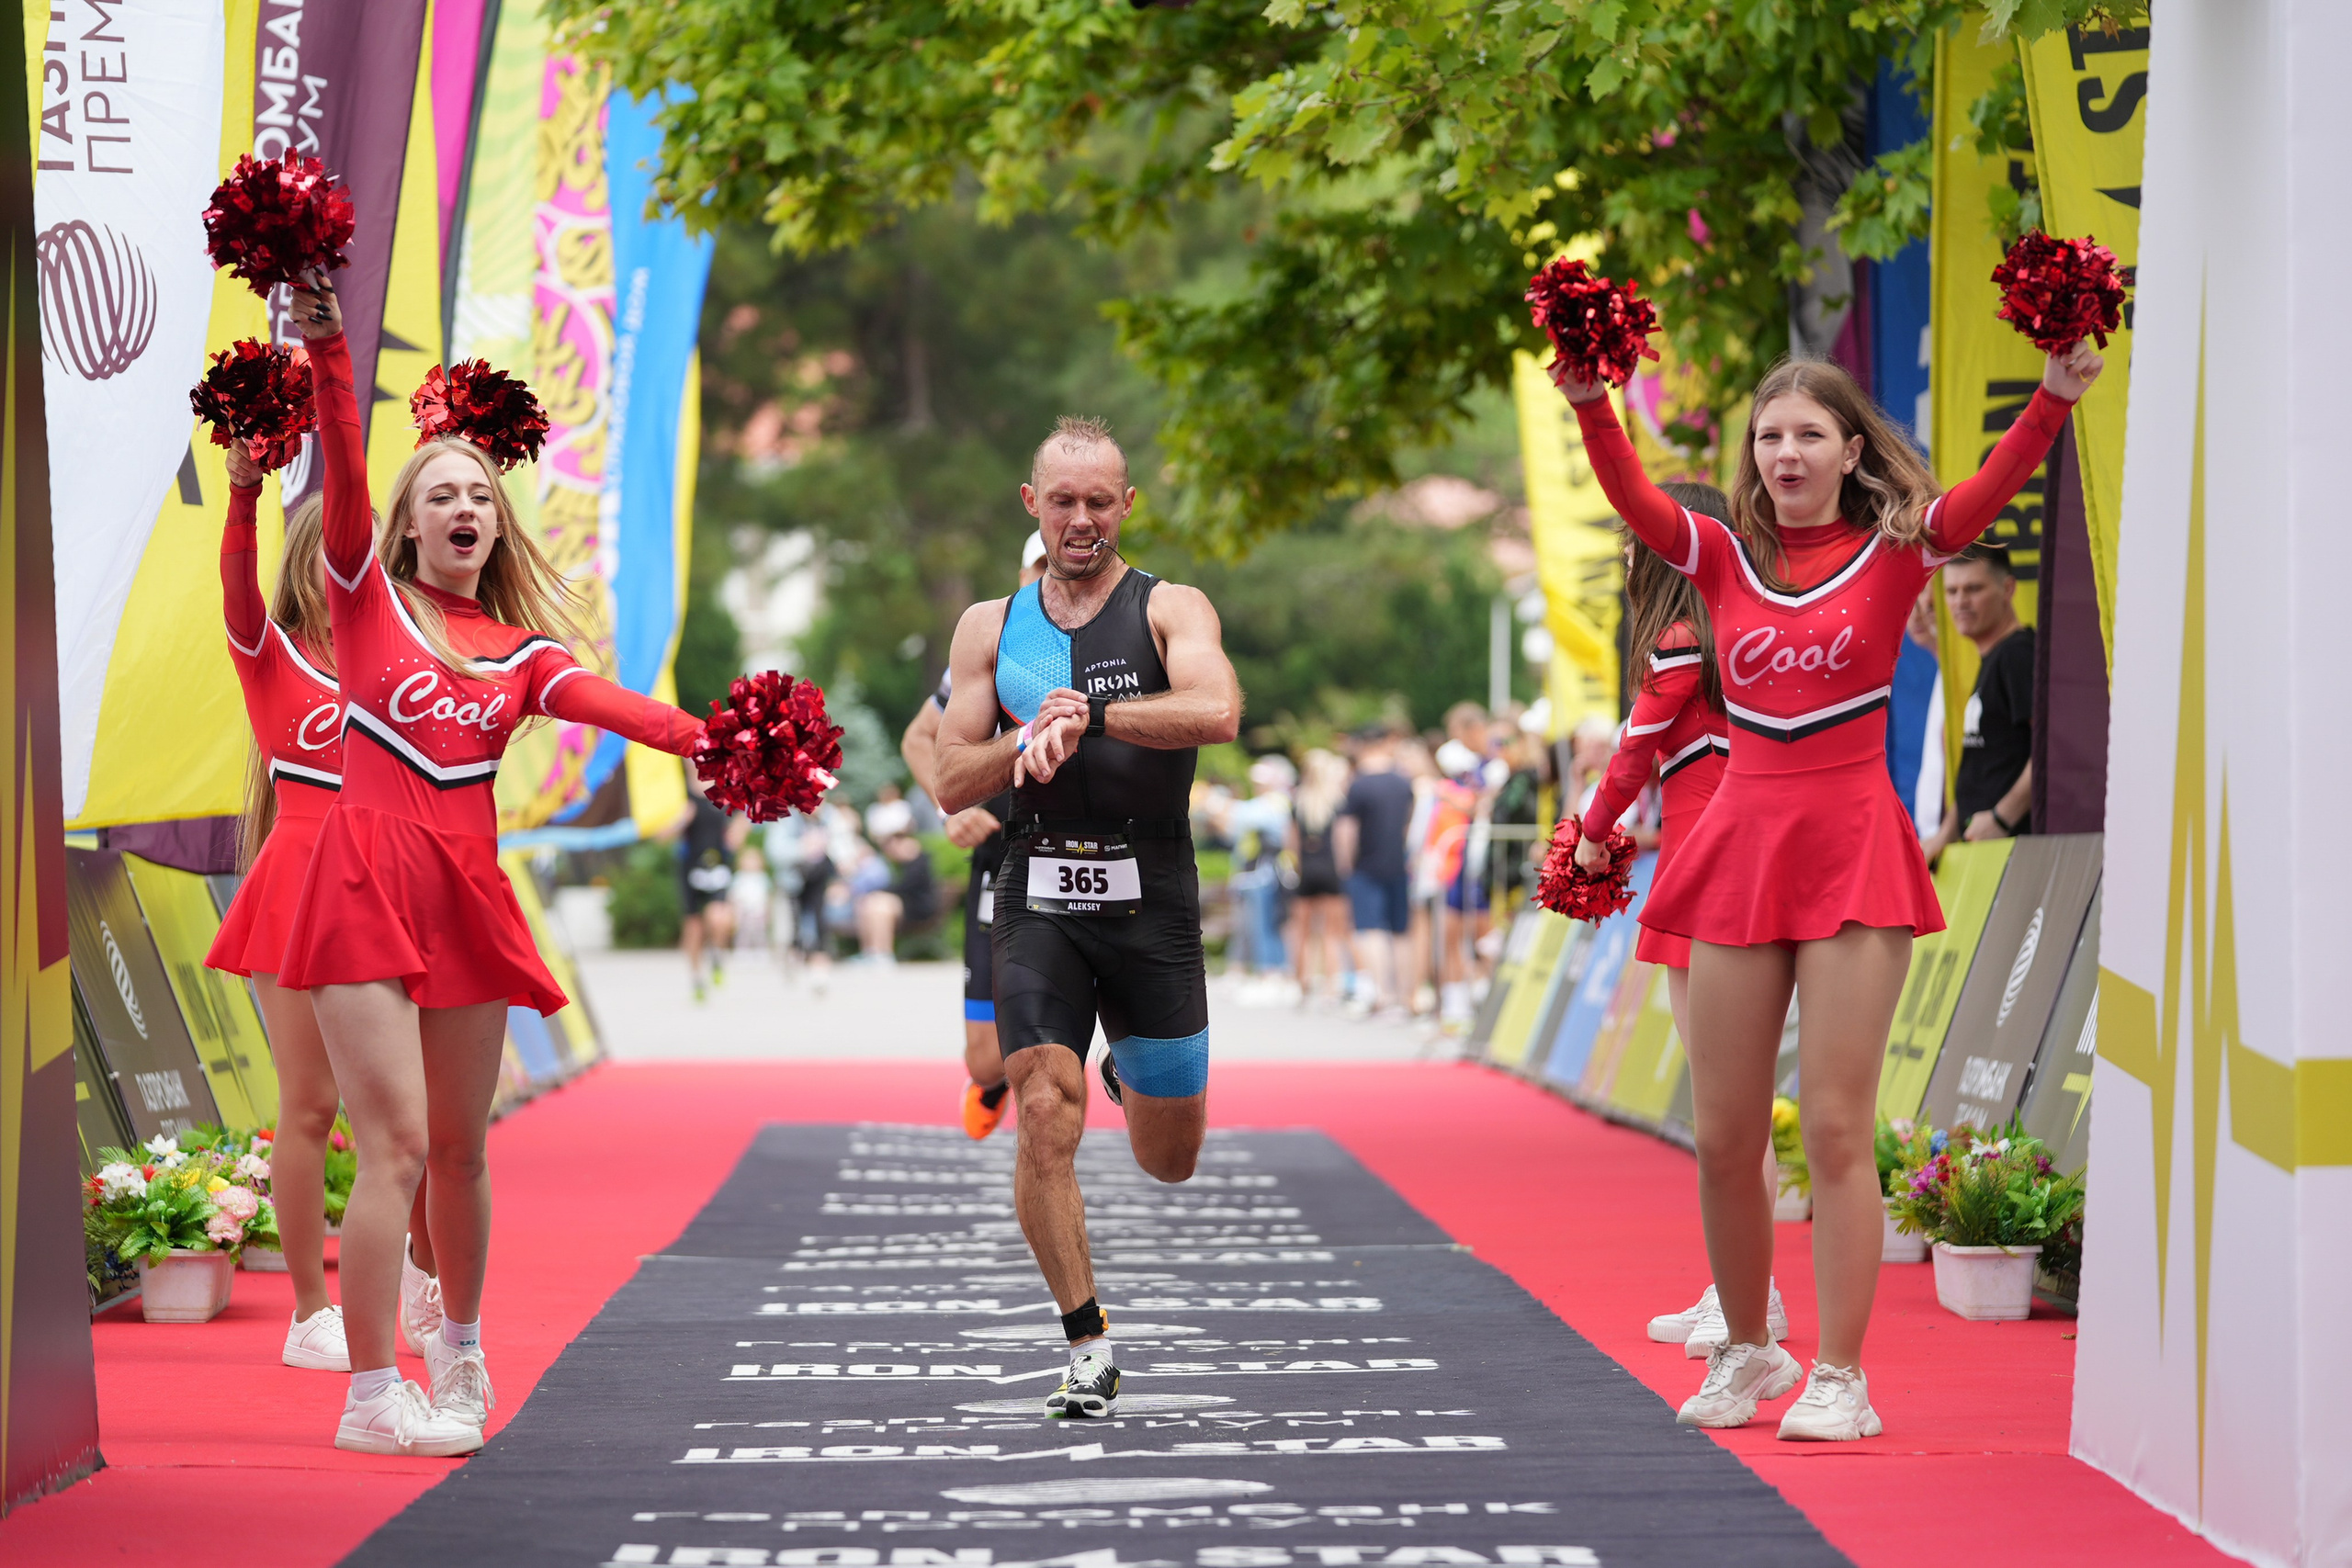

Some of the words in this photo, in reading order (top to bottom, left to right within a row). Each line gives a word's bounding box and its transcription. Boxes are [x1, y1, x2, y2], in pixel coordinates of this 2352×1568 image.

[254, 0, 304, 166] ОМБА
[1084, 658, 1127, 673] APTONIA
[1728, 625, 1854, 686] Cool
[1087, 671, 1139, 694] IRON
[389, 670, 506, 731] Cool
[1065, 840, 1079, 849] IRON
[1083, 840, 1099, 850] STAR
[1057, 865, 1109, 895] 365
[1068, 901, 1102, 911] ALEKSEY
[760, 1299, 1001, 1312] IRON
[1129, 1296, 1383, 1309] STAR
[730, 1363, 1003, 1376] IRON
[1148, 1359, 1439, 1372] STAR
[683, 1445, 1001, 1460] IRON
[1171, 1435, 1508, 1452] STAR
[612, 1543, 994, 1567] IRON
[1195, 1545, 1601, 1568] STAR
